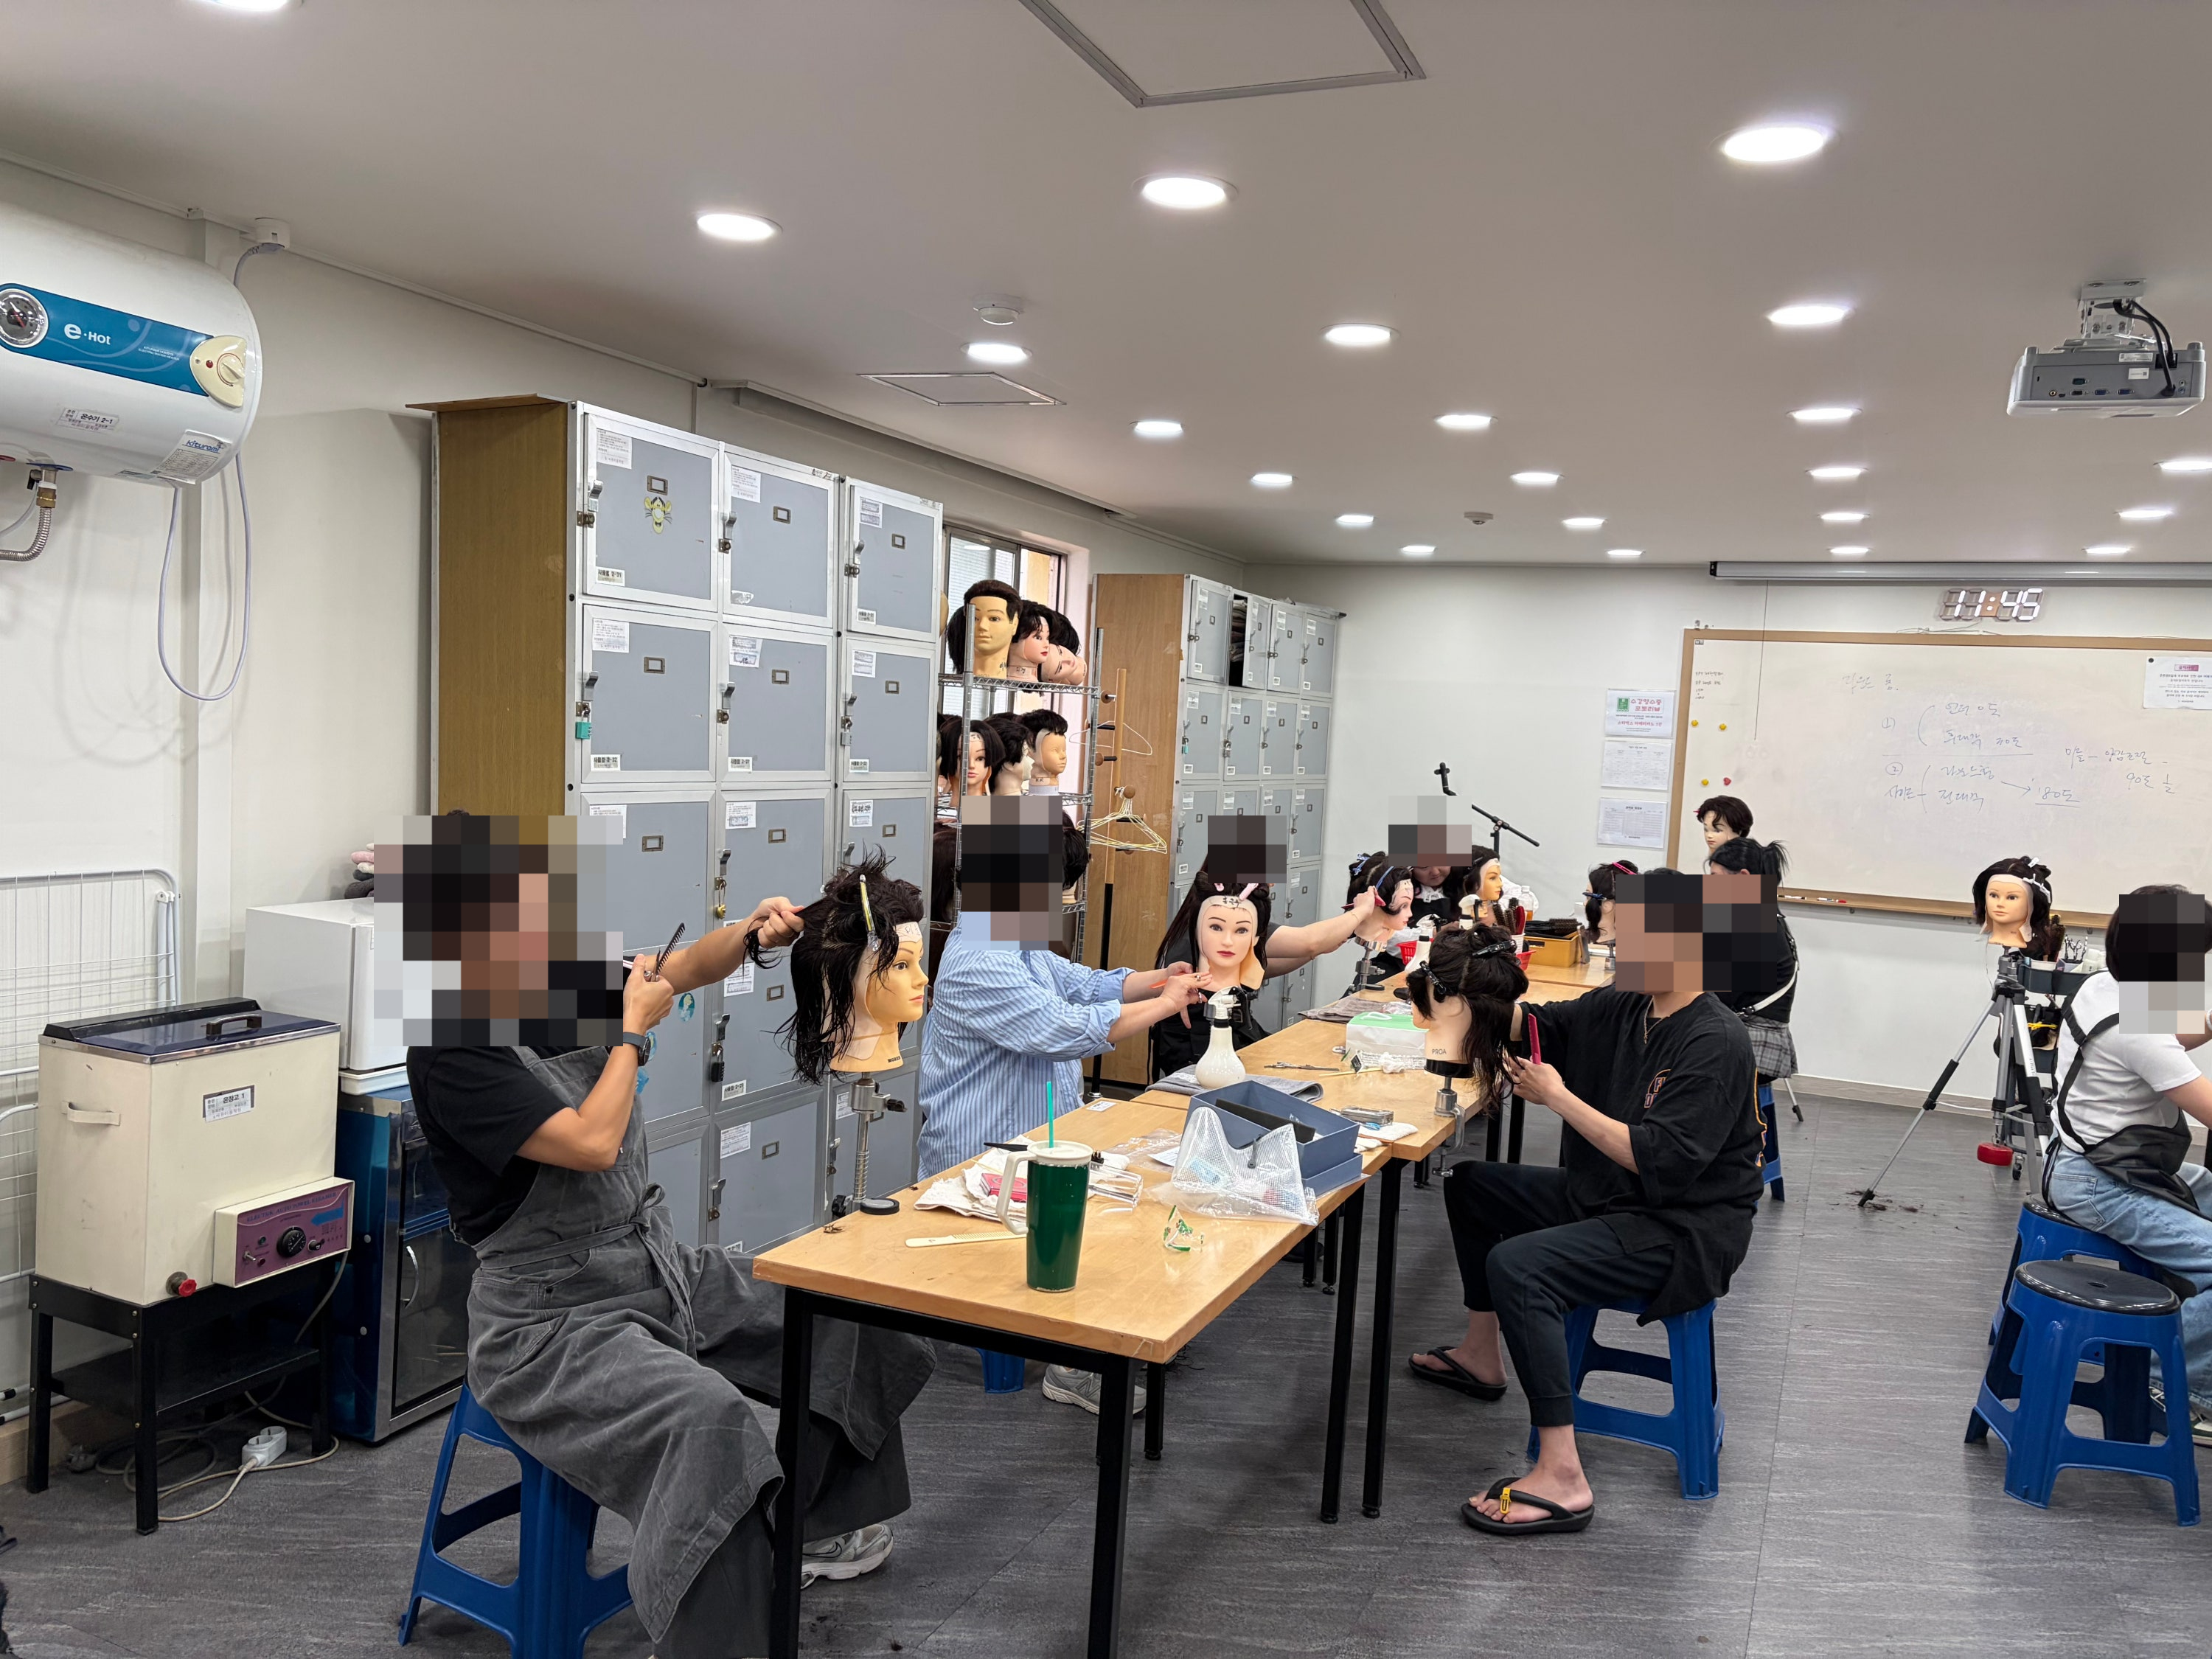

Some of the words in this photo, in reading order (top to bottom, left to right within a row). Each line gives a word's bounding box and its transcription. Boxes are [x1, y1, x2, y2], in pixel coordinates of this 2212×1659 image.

[80, 413, 100, 422] 온수기
[1953, 588, 2043, 621] 11:45
[223, 1094, 240, 1104] 온장고
